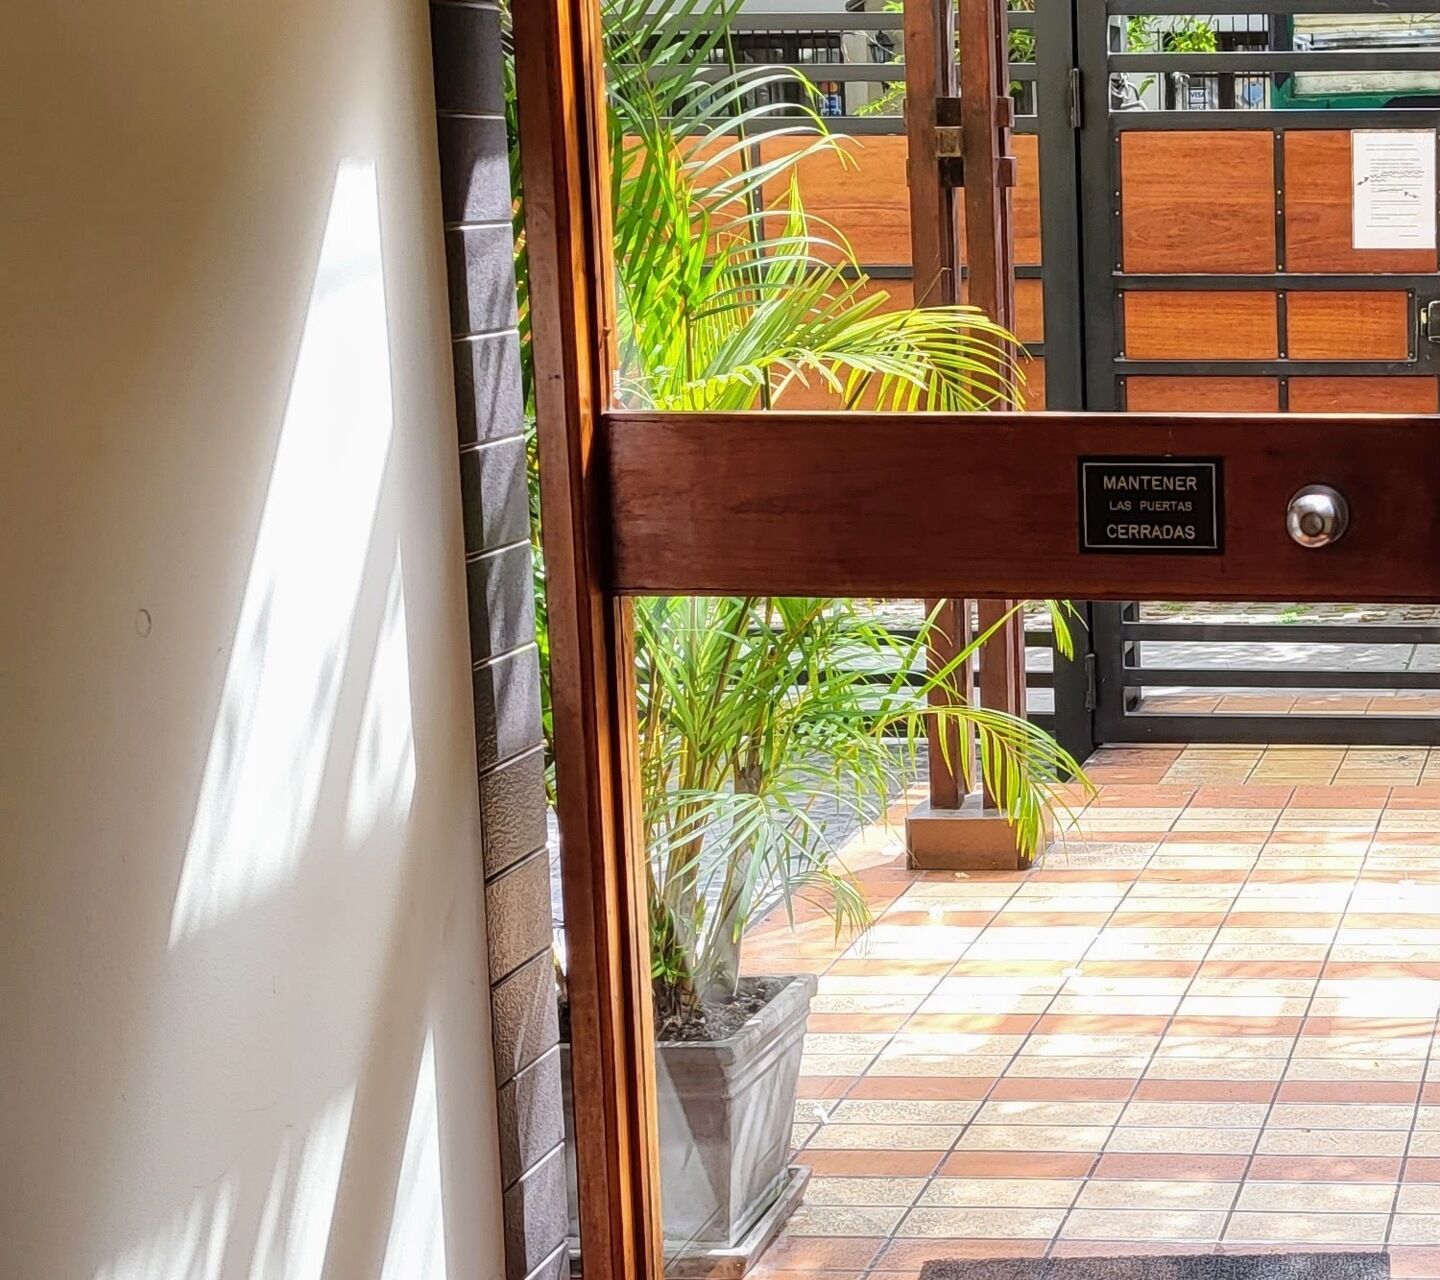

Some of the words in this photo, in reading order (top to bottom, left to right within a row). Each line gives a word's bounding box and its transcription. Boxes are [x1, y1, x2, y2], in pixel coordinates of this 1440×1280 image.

[1103, 475, 1197, 491] MANTENER
[1109, 500, 1131, 511] LAS
[1140, 500, 1192, 512] PUERTAS
[1106, 524, 1196, 539] CERRADAS
